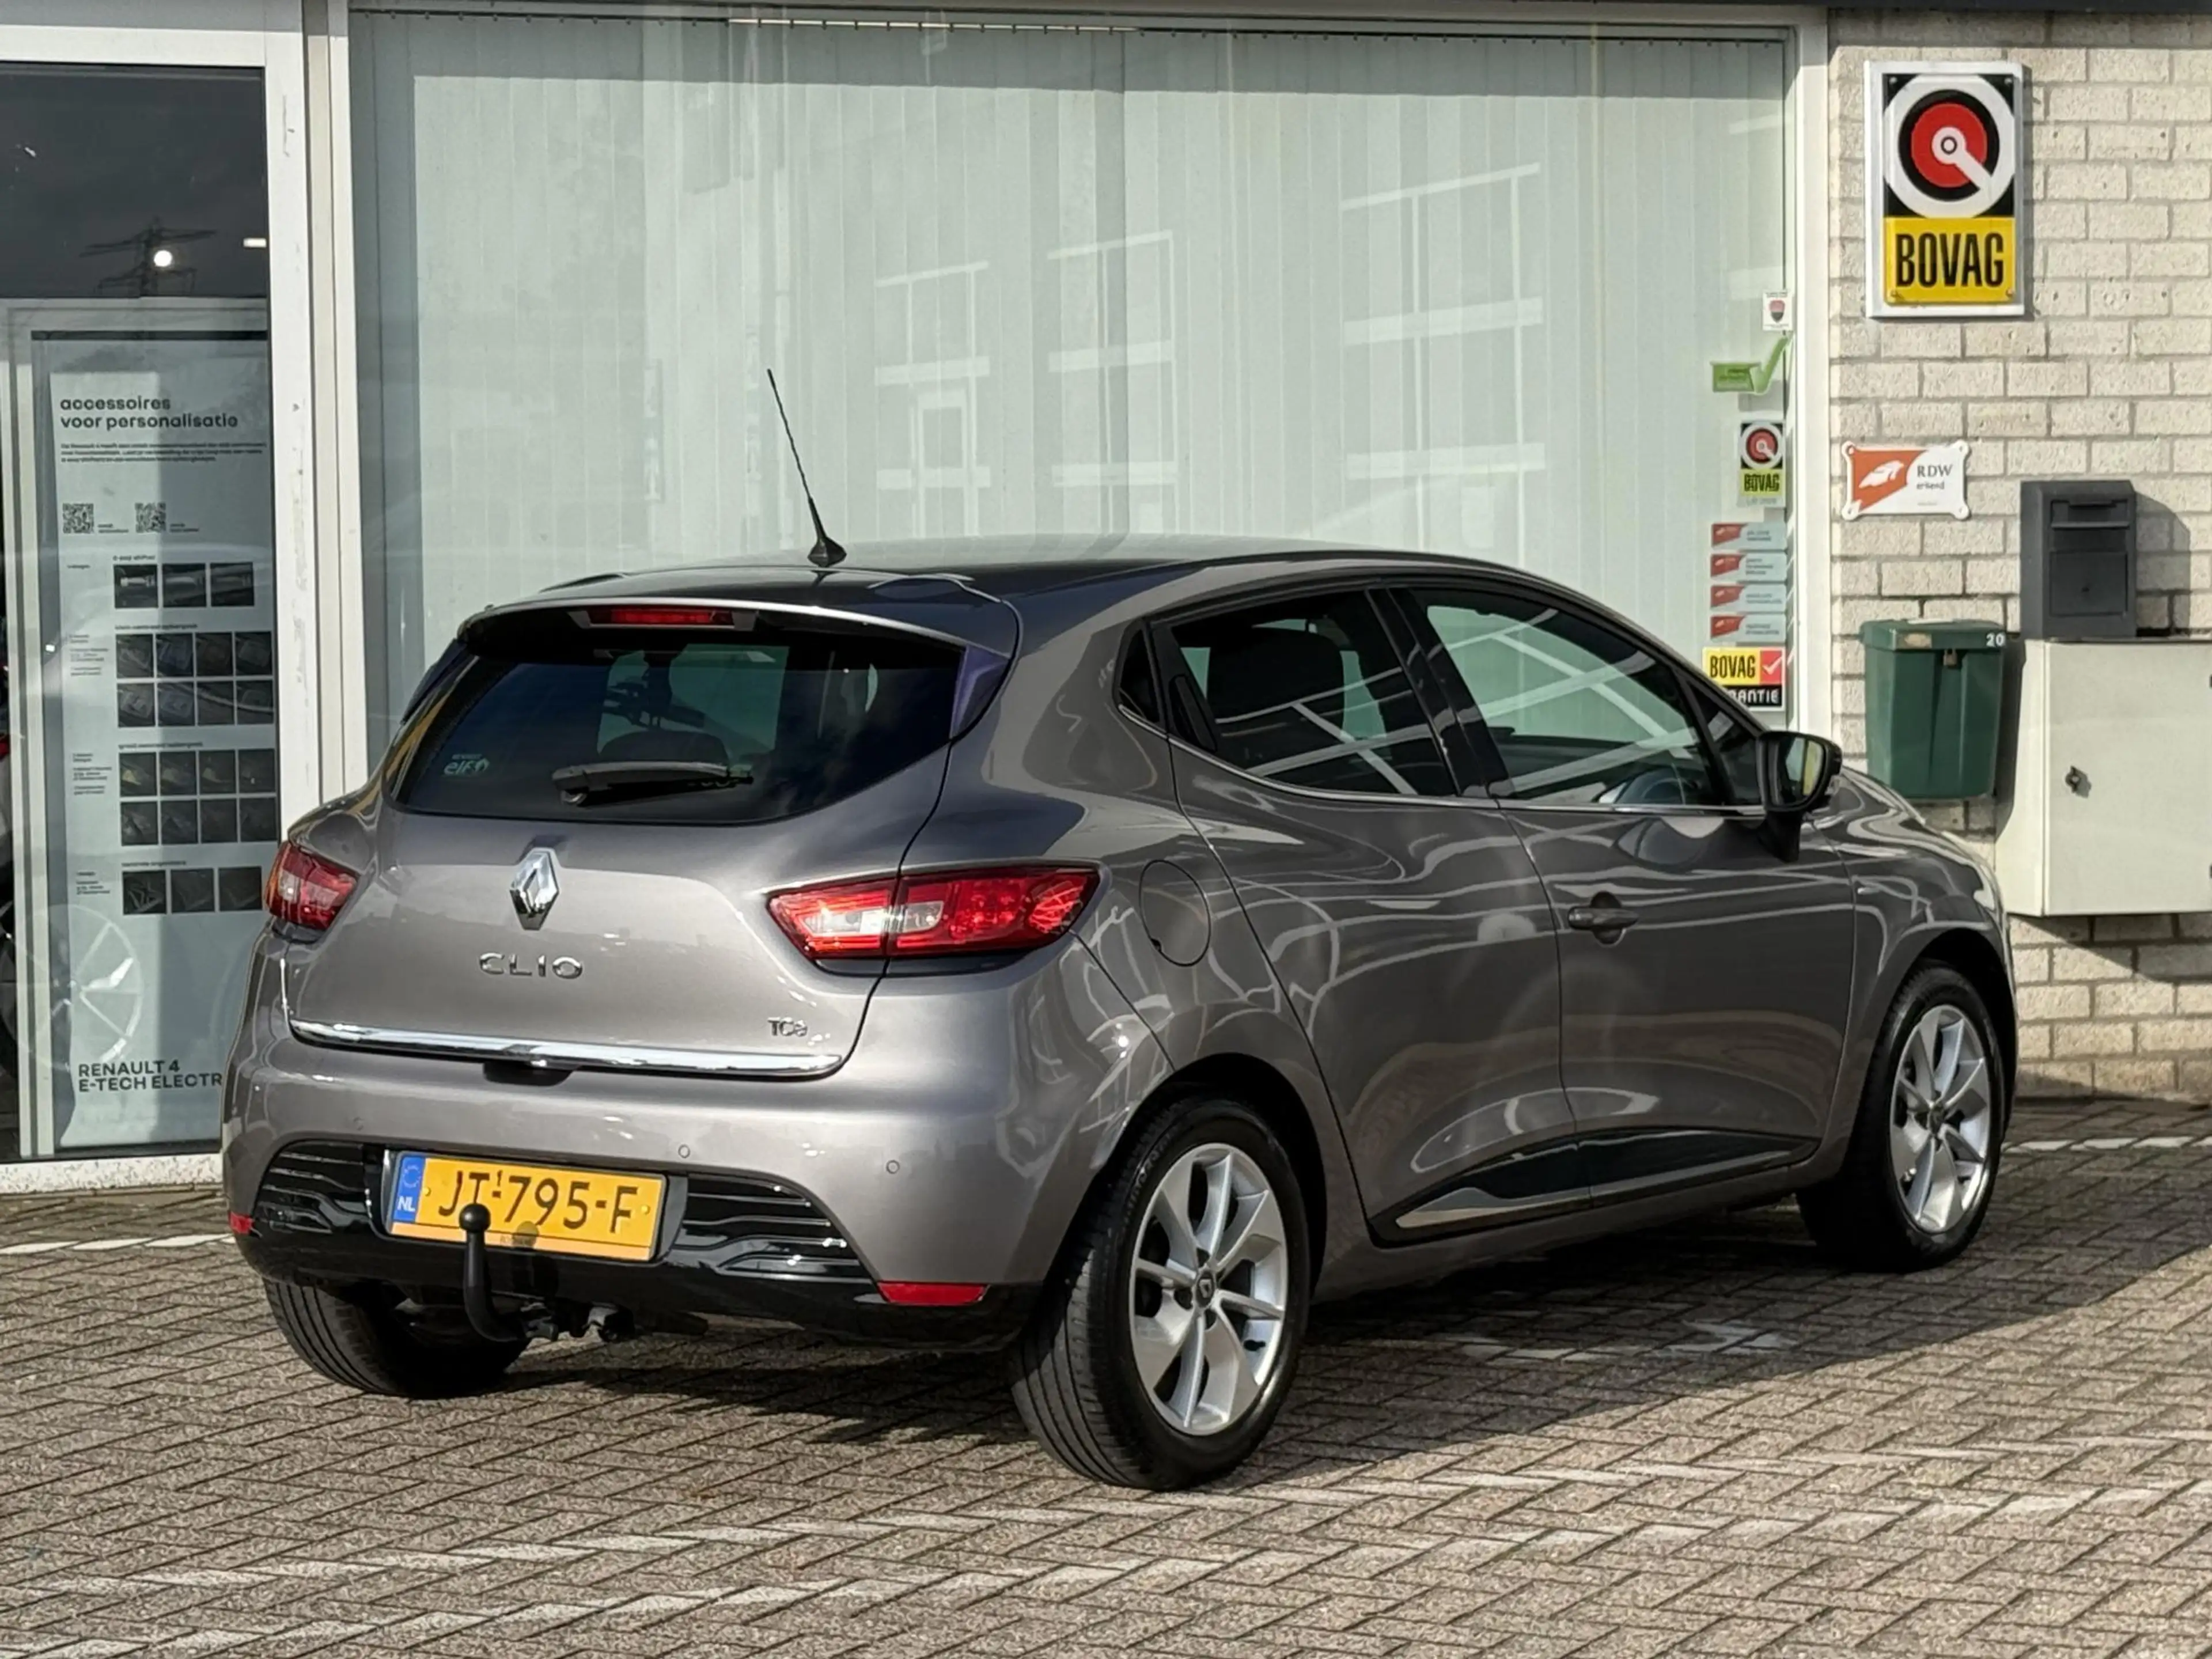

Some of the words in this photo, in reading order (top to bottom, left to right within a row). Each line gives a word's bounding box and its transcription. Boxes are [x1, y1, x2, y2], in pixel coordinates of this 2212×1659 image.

[1895, 232, 2003, 288] BOVAG
[60, 396, 171, 410] accessoires
[60, 416, 103, 429] voor
[107, 413, 238, 431] personalisatie
[1916, 464, 1953, 477] RDW
[1744, 473, 1780, 491] BOVAG
[1986, 632, 2005, 647] 20
[1710, 656, 1756, 678] BOVAG
[1728, 689, 1779, 703] RANTIE
[479, 952, 584, 979] CLIO
[78, 1060, 165, 1077] RENAULT
[169, 1059, 180, 1072] 4
[79, 1077, 146, 1092] E-TECH
[151, 1073, 222, 1089] ELECTR
[397, 1195, 415, 1212] NL
[438, 1170, 639, 1233] JT-795-F
